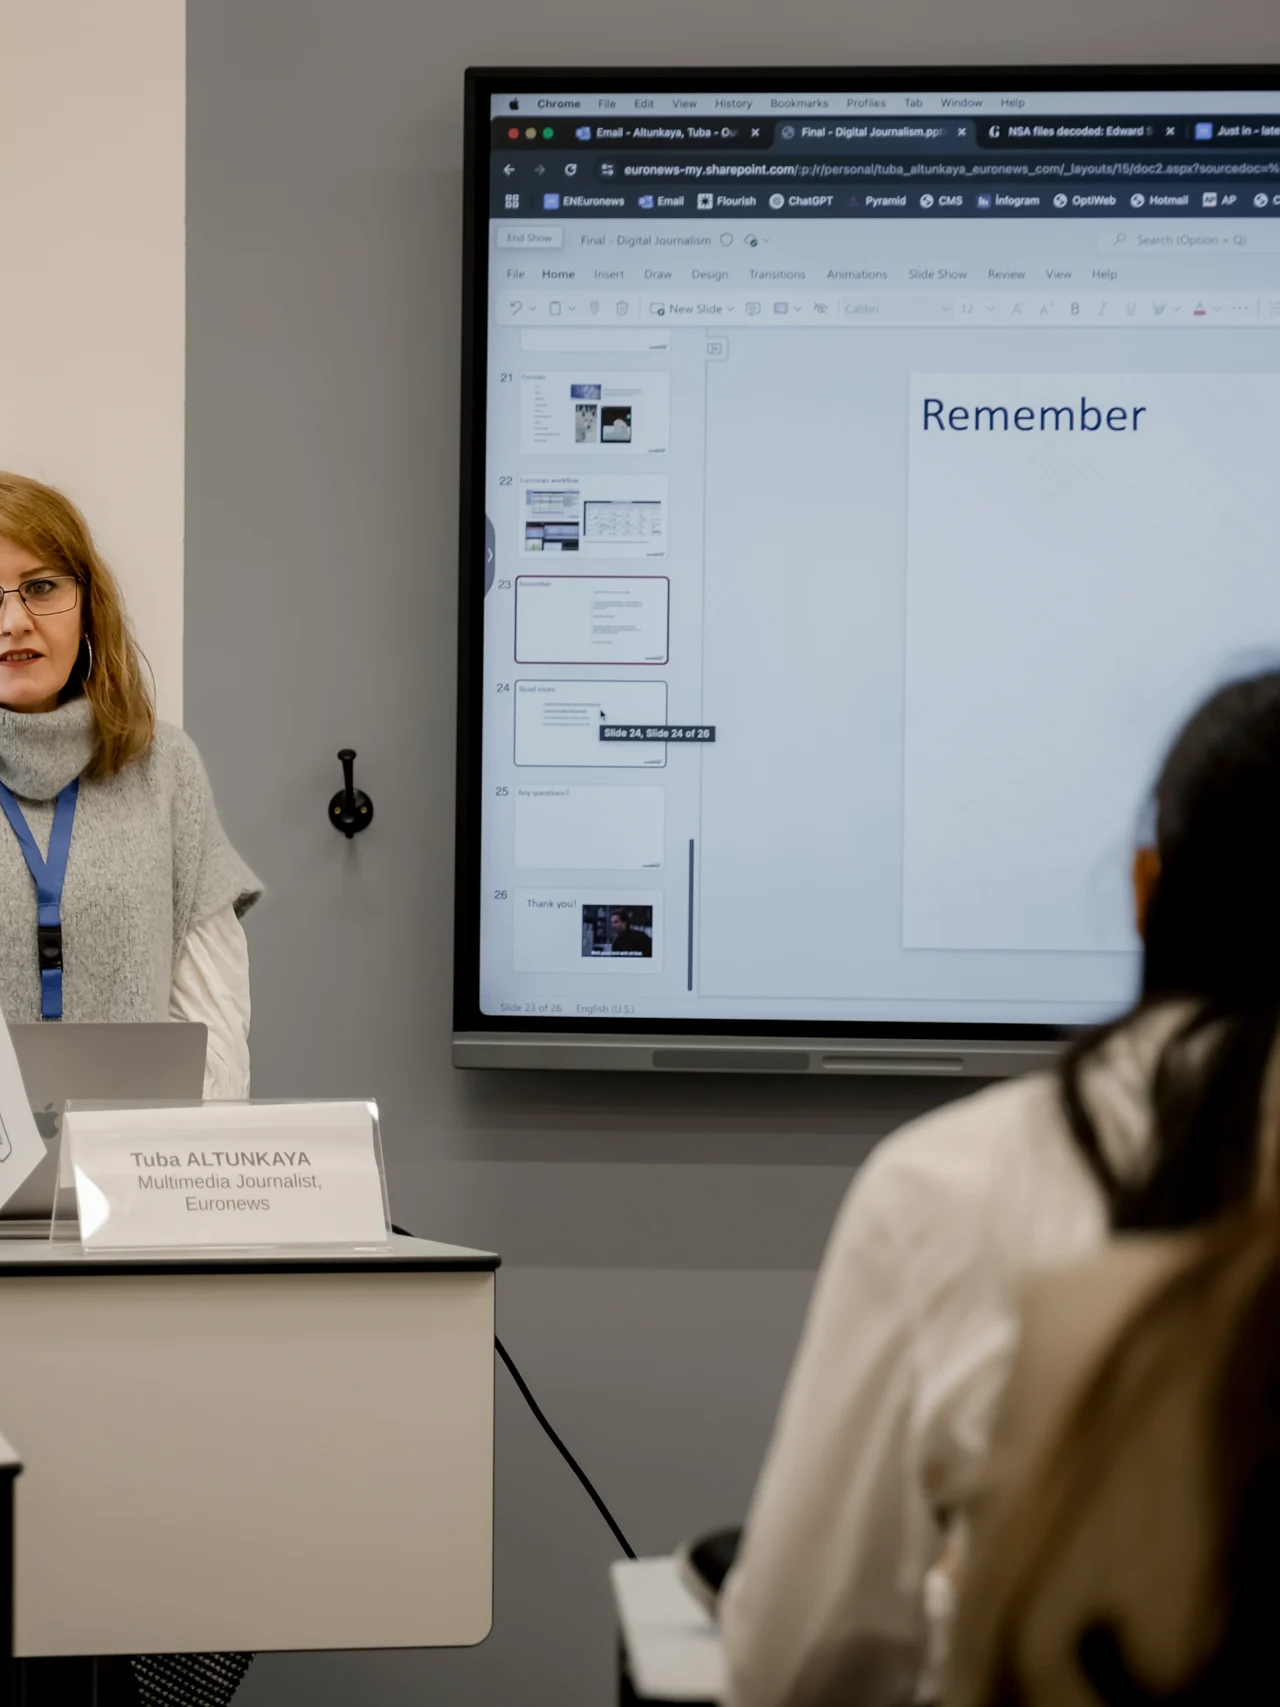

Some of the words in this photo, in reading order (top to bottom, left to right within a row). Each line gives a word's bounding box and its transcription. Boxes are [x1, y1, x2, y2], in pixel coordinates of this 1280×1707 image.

[537, 98, 581, 109] Chrome
[598, 98, 616, 109] File
[634, 98, 654, 109] Edit
[672, 98, 697, 108] View
[715, 98, 753, 111] History
[770, 98, 829, 108] Bookmarks
[846, 98, 886, 108] Profiles
[905, 98, 923, 108] Tab
[941, 97, 983, 108] Window
[1001, 97, 1026, 111] Help
[596, 127, 624, 138] Email
[633, 127, 685, 140] Altunkaya,
[688, 127, 712, 138] Tuba
[801, 127, 826, 138] Final
[835, 126, 868, 140] Digital
[1008, 126, 1031, 137] NSA
[1033, 126, 1055, 137] files
[1056, 126, 1104, 137] decoded:
[1106, 126, 1144, 137] Edward
[1217, 126, 1240, 137] Just
[1242, 126, 1252, 136] in
[563, 196, 625, 207] ENEuronews
[657, 196, 685, 207] Email
[717, 196, 756, 207] Flourish
[788, 196, 834, 207] ChatGPT
[865, 196, 907, 209] Pyramid
[938, 195, 963, 206] CMS
[1072, 195, 1117, 207] OptiWeb
[1149, 195, 1189, 206] Hotmail
[1221, 195, 1237, 206] AP
[507, 233, 524, 243] End
[526, 233, 552, 243] Show
[581, 234, 605, 246] Final
[617, 234, 651, 248] Digital
[655, 234, 711, 246] Journalism
[1137, 234, 1173, 246] Search
[1176, 234, 1218, 248] (Option
[1233, 234, 1247, 248] Q)
[507, 269, 525, 280] File
[542, 269, 575, 280] Home
[594, 269, 624, 280] Insert
[644, 269, 672, 280] Draw
[692, 269, 729, 283] Design
[749, 269, 806, 280] Transitions
[827, 269, 888, 280] Animations
[908, 269, 935, 280] Slide
[938, 269, 967, 280] Show
[988, 269, 1025, 280] Review
[1046, 269, 1072, 280] View
[1092, 269, 1118, 283] Help
[669, 303, 693, 314] New
[697, 303, 723, 314] Slide
[845, 303, 880, 314] Calibri
[961, 303, 974, 314] 12
[501, 373, 513, 383] 21
[922, 396, 1147, 432] Remember
[499, 476, 513, 486] 22
[498, 580, 512, 590] 23
[496, 684, 510, 693] 24
[604, 728, 627, 738] Slide
[629, 728, 644, 739] 24,
[646, 728, 669, 738] Slide
[671, 728, 683, 738] 24
[685, 728, 695, 738] of
[697, 728, 710, 738] 26
[495, 787, 508, 796] 25
[494, 890, 507, 899] 26
[527, 899, 554, 908] Thank
[557, 899, 576, 911] you!
[500, 1003, 522, 1012] Slide
[524, 1003, 536, 1012] 23
[538, 1003, 548, 1012] of
[550, 1003, 562, 1012] 26
[576, 1003, 609, 1015] English
[130, 1152, 181, 1168] Tuba
[187, 1151, 312, 1168] ALTUNKAYA
[138, 1174, 231, 1190] Multimedia
[236, 1173, 322, 1191] Journalist,
[185, 1196, 270, 1211] Euronews
